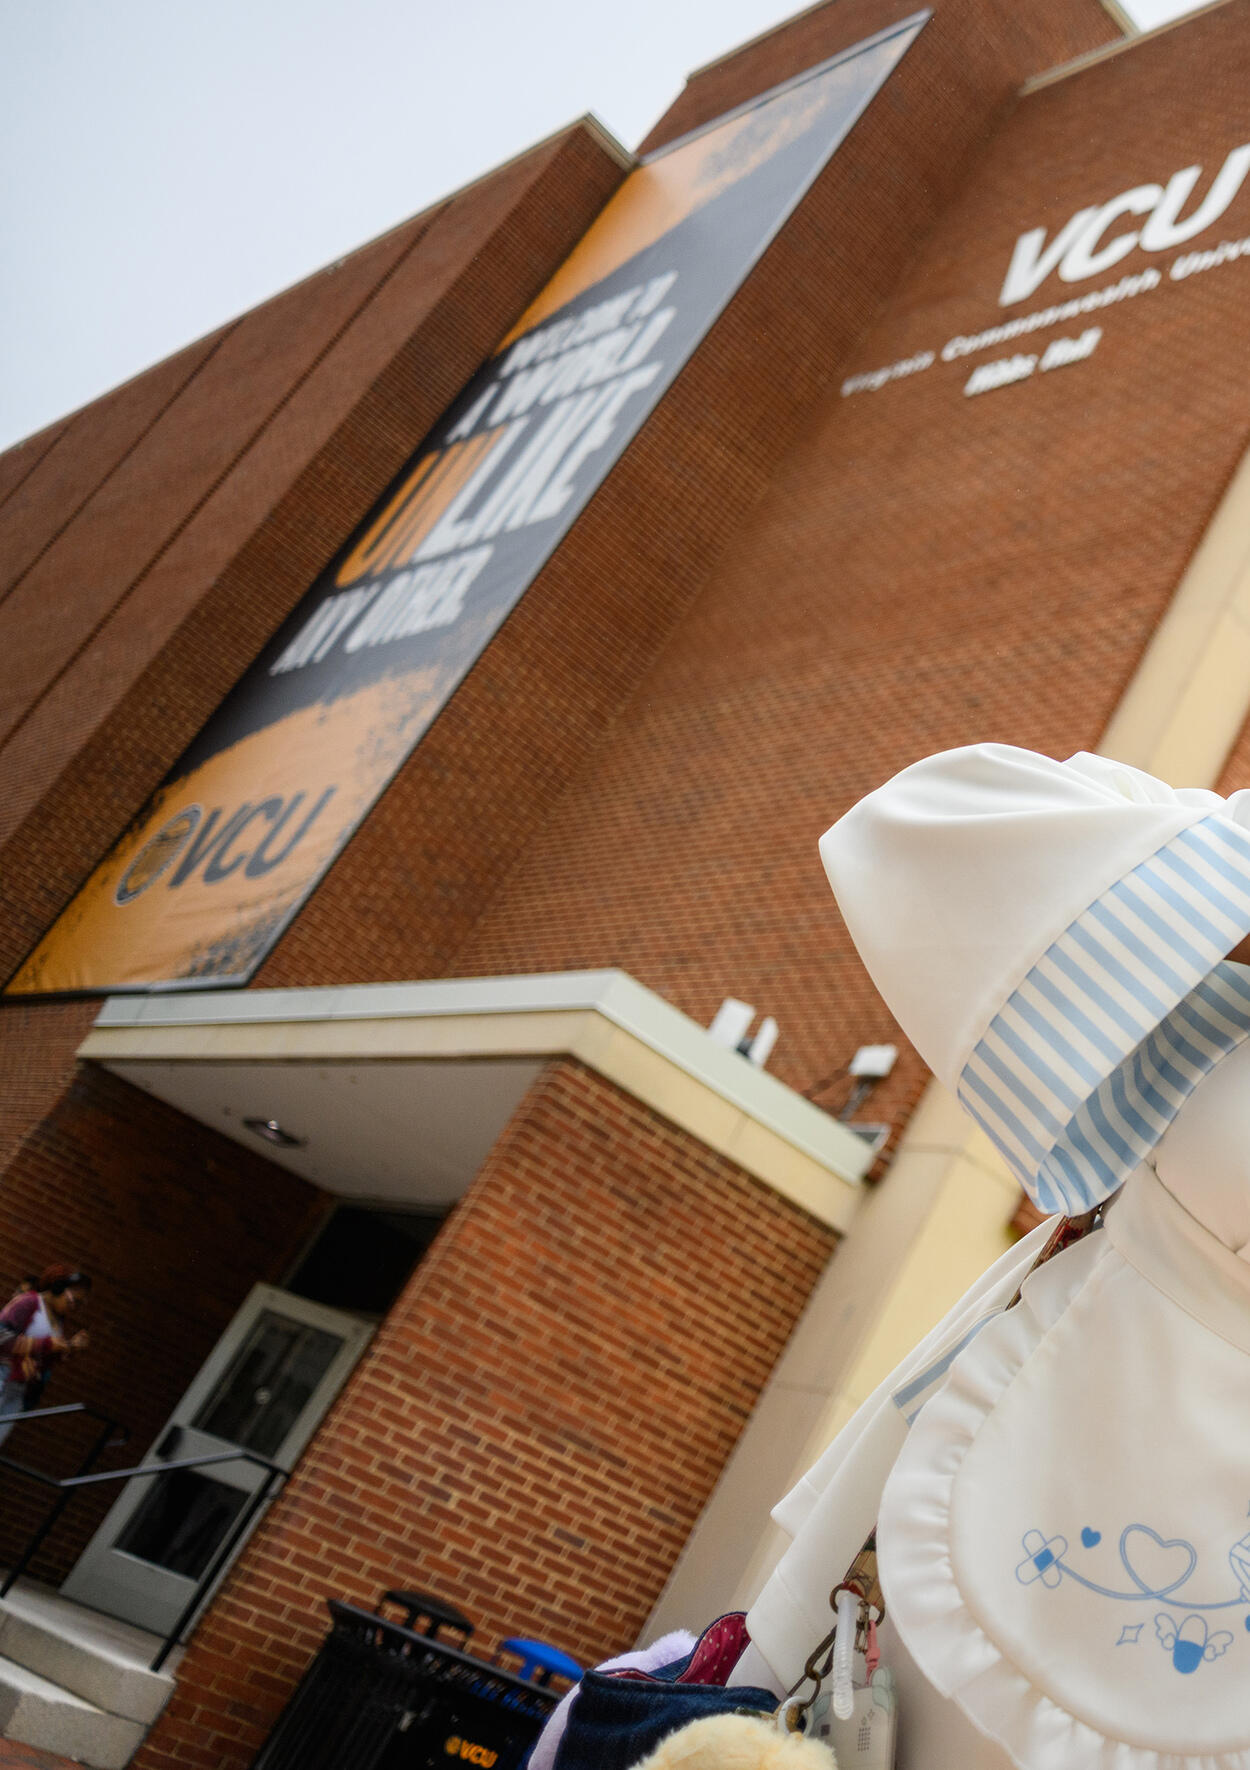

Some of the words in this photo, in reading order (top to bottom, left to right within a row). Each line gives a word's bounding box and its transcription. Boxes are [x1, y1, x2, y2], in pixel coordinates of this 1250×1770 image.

[335, 362, 663, 588] UNLIKE
[168, 785, 337, 890] VCU
[460, 1740, 499, 1768] VCU
